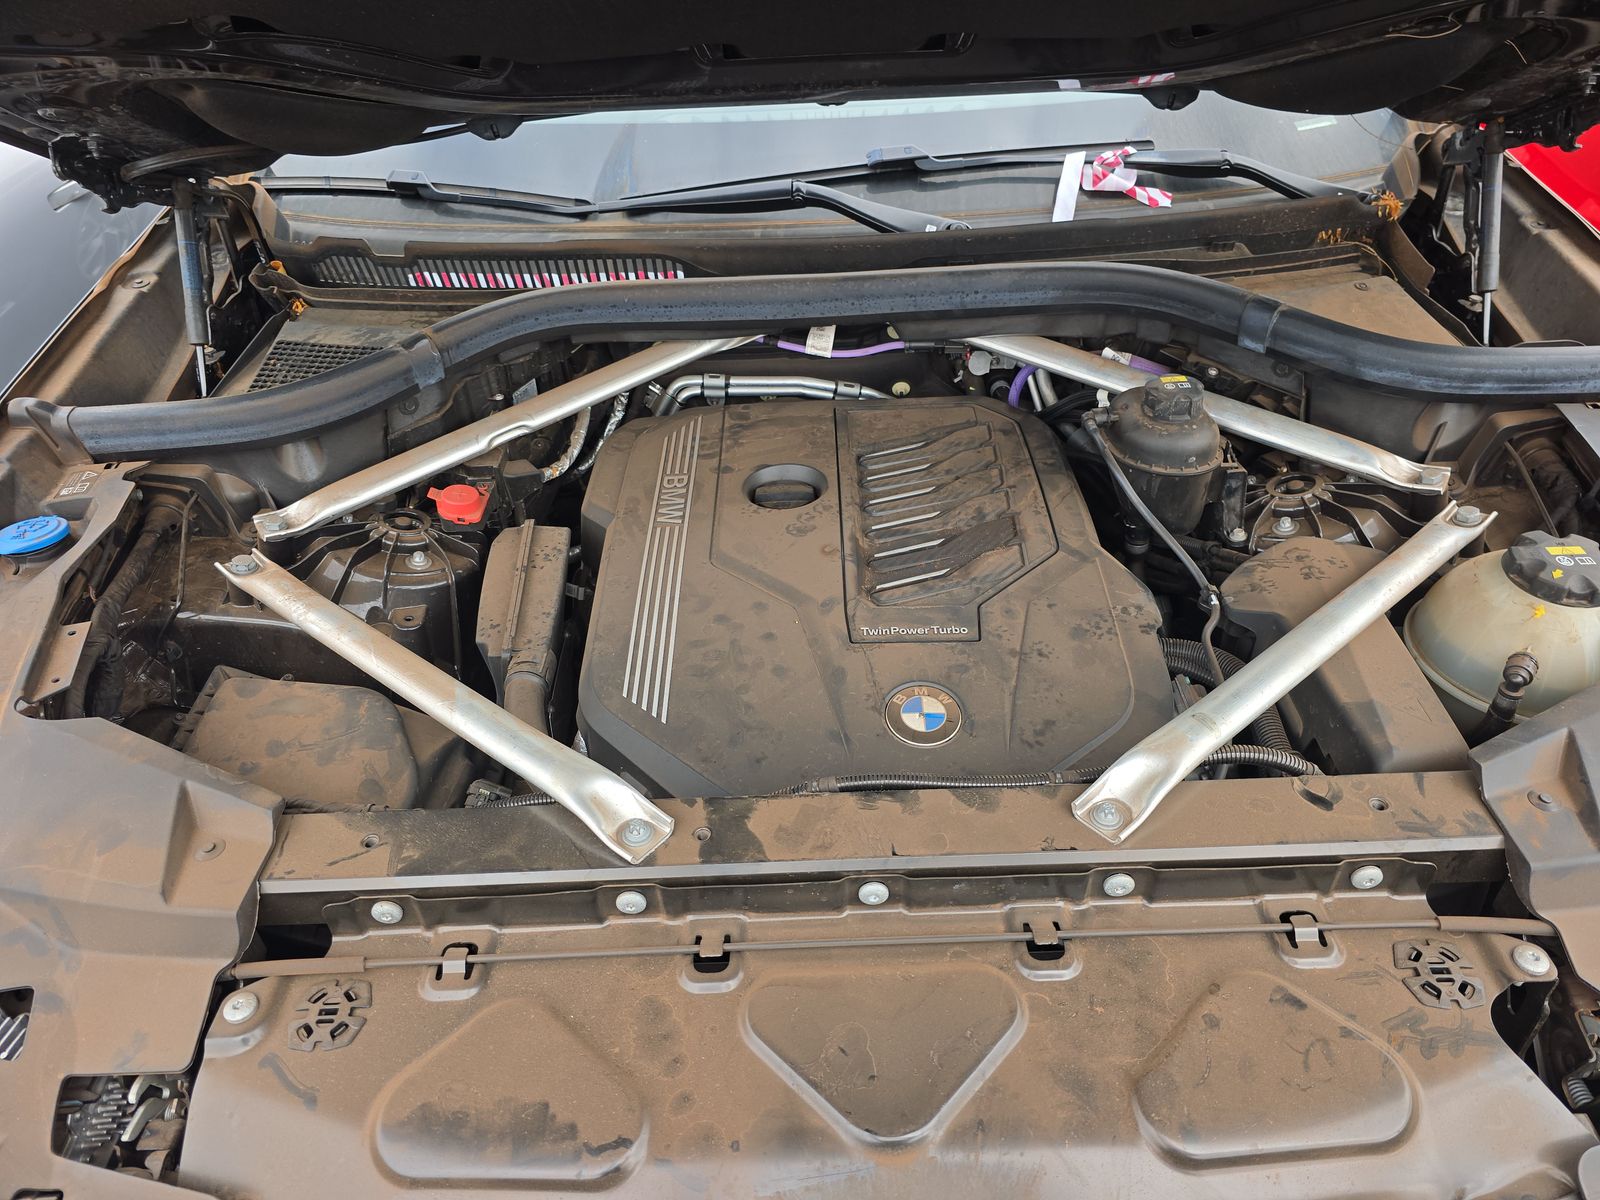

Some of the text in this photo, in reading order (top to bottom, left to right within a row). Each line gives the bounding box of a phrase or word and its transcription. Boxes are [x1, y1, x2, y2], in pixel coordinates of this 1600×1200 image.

[656, 475, 688, 524] BMW
[931, 625, 969, 634] Turbo
[893, 687, 953, 705] BMW
